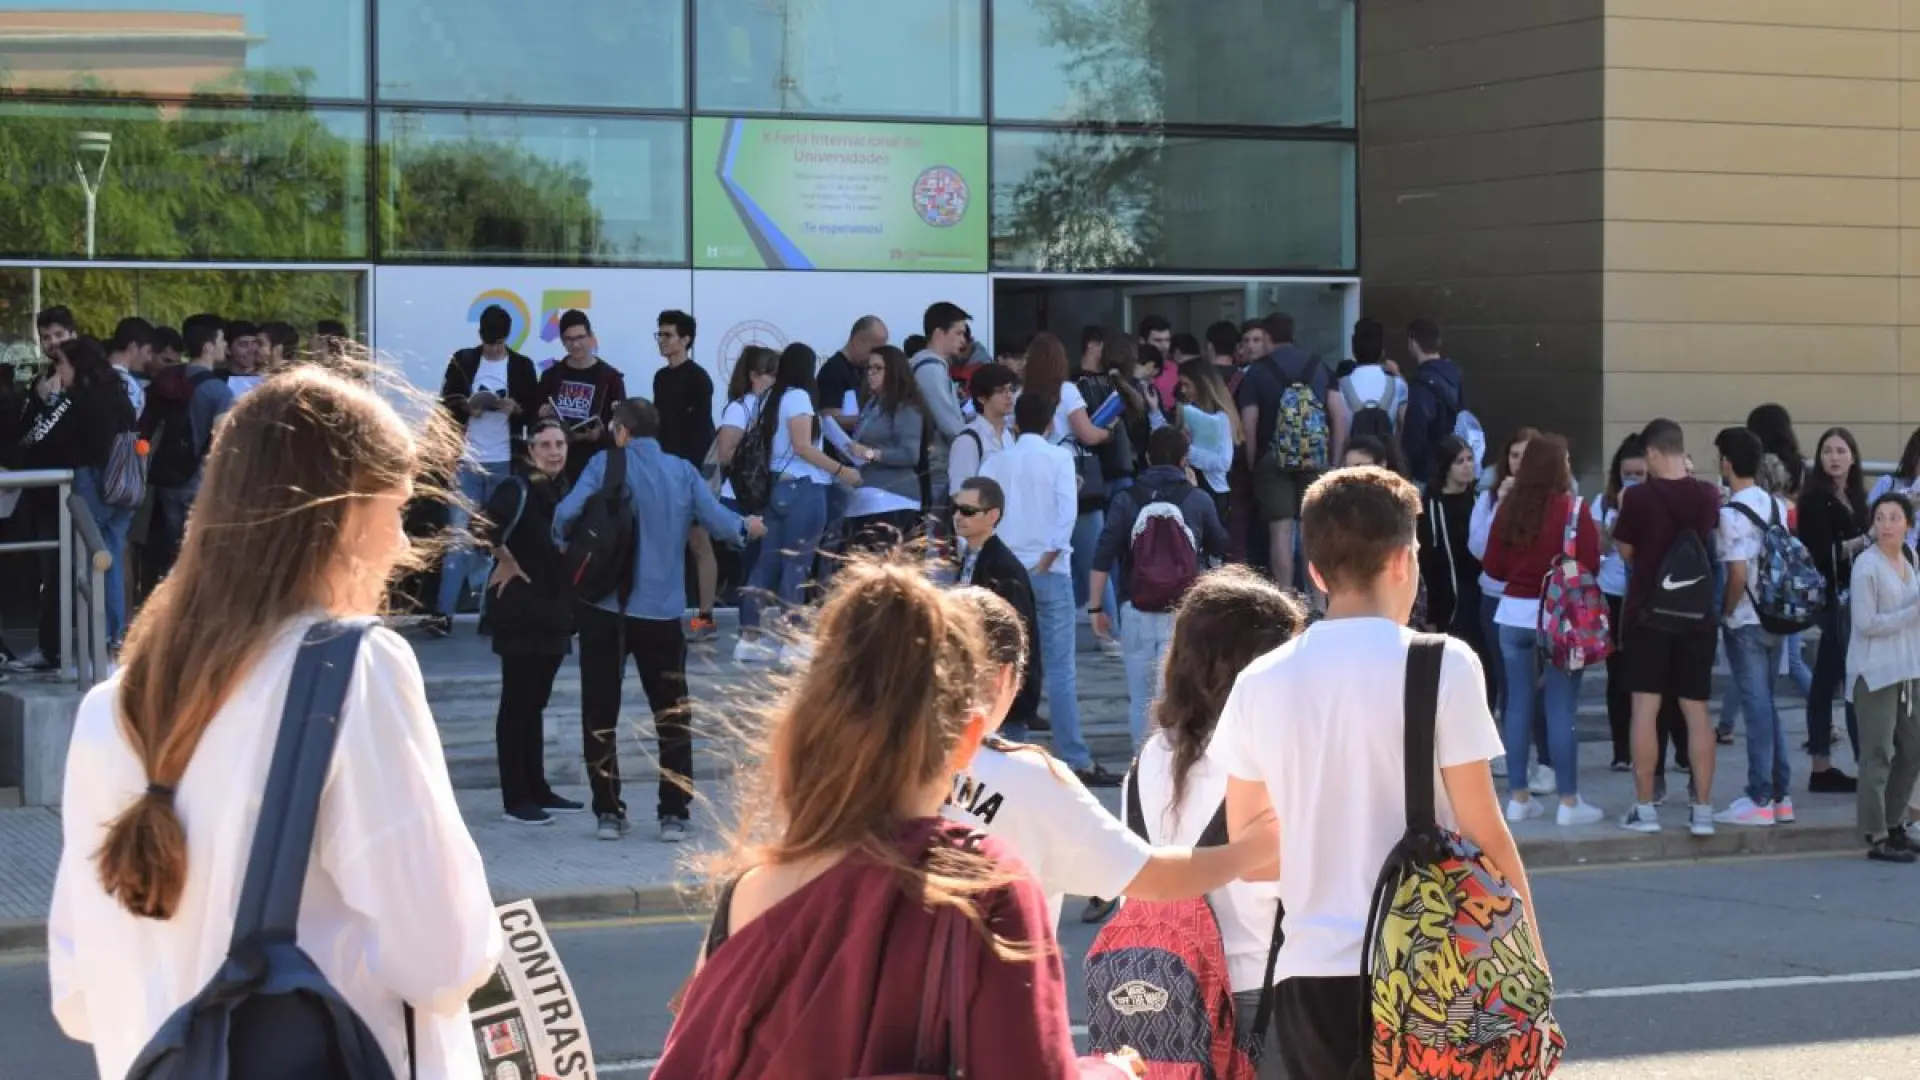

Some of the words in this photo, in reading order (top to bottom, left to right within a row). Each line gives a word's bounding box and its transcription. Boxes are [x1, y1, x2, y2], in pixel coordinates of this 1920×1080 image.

[810, 131, 902, 149] Internacional
[794, 149, 889, 166] Universidades
[500, 908, 590, 1080] CONTRAS
